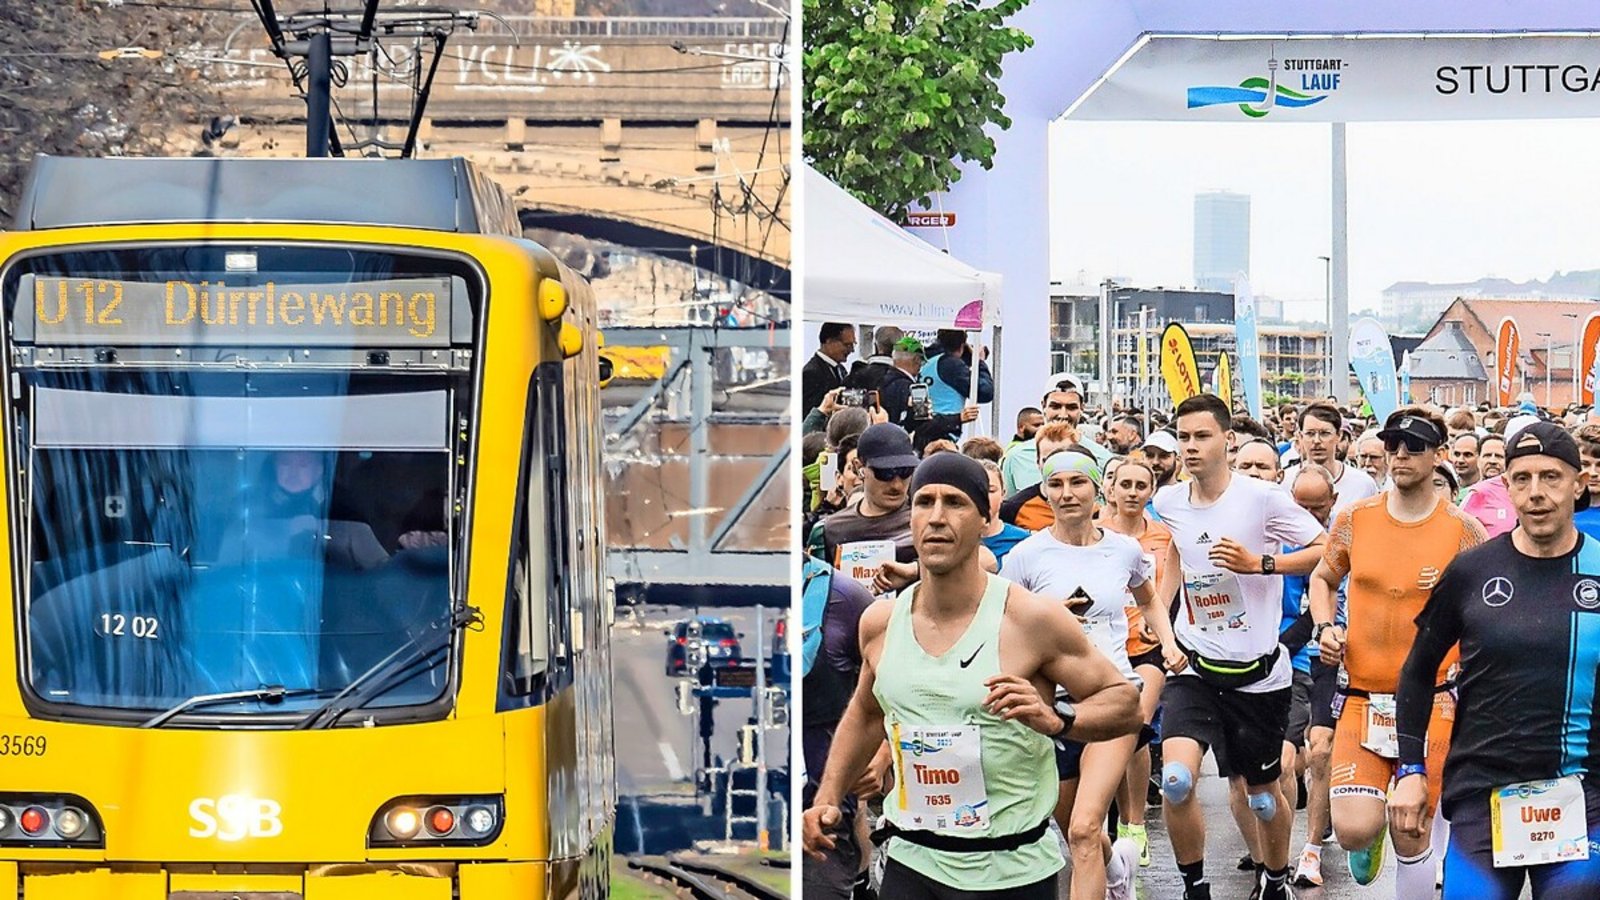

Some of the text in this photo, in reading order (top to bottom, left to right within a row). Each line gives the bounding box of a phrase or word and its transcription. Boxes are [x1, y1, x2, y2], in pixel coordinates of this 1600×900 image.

[1302, 73, 1341, 90] LAUF
[907, 216, 949, 225] RGER
[35, 280, 435, 338] U12 Dürrlewang
[1194, 592, 1231, 609] Robin
[101, 613, 158, 639] 12 02
[0, 734, 47, 756] 3569
[913, 763, 961, 786] Timo
[924, 795, 952, 806] 7635
[188, 794, 284, 842] SSB
[1521, 805, 1562, 824] Uwe
[1529, 831, 1556, 842] 8270
